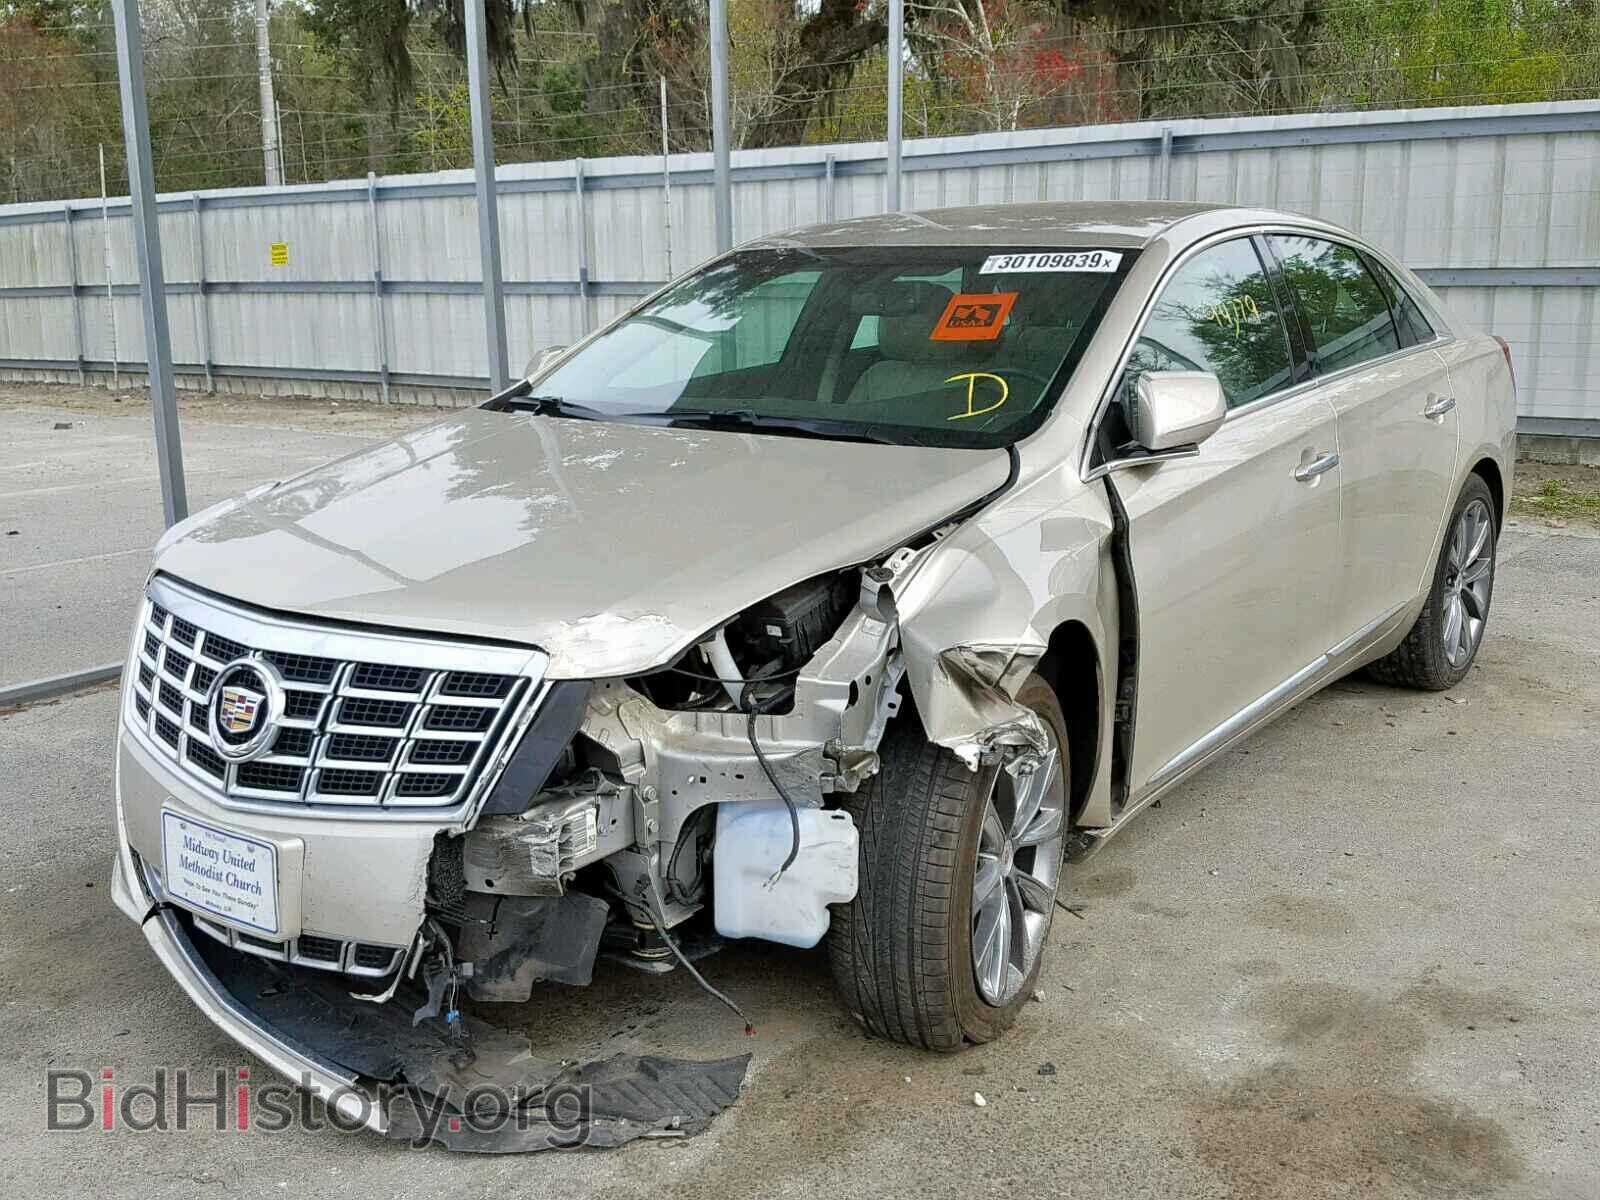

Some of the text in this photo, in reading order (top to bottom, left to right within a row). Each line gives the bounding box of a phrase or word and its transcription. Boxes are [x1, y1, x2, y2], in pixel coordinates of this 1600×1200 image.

[944, 372, 1009, 421] D
[183, 835, 219, 865] Midway
[223, 849, 256, 872] United
[179, 855, 262, 896] Methodist Church
